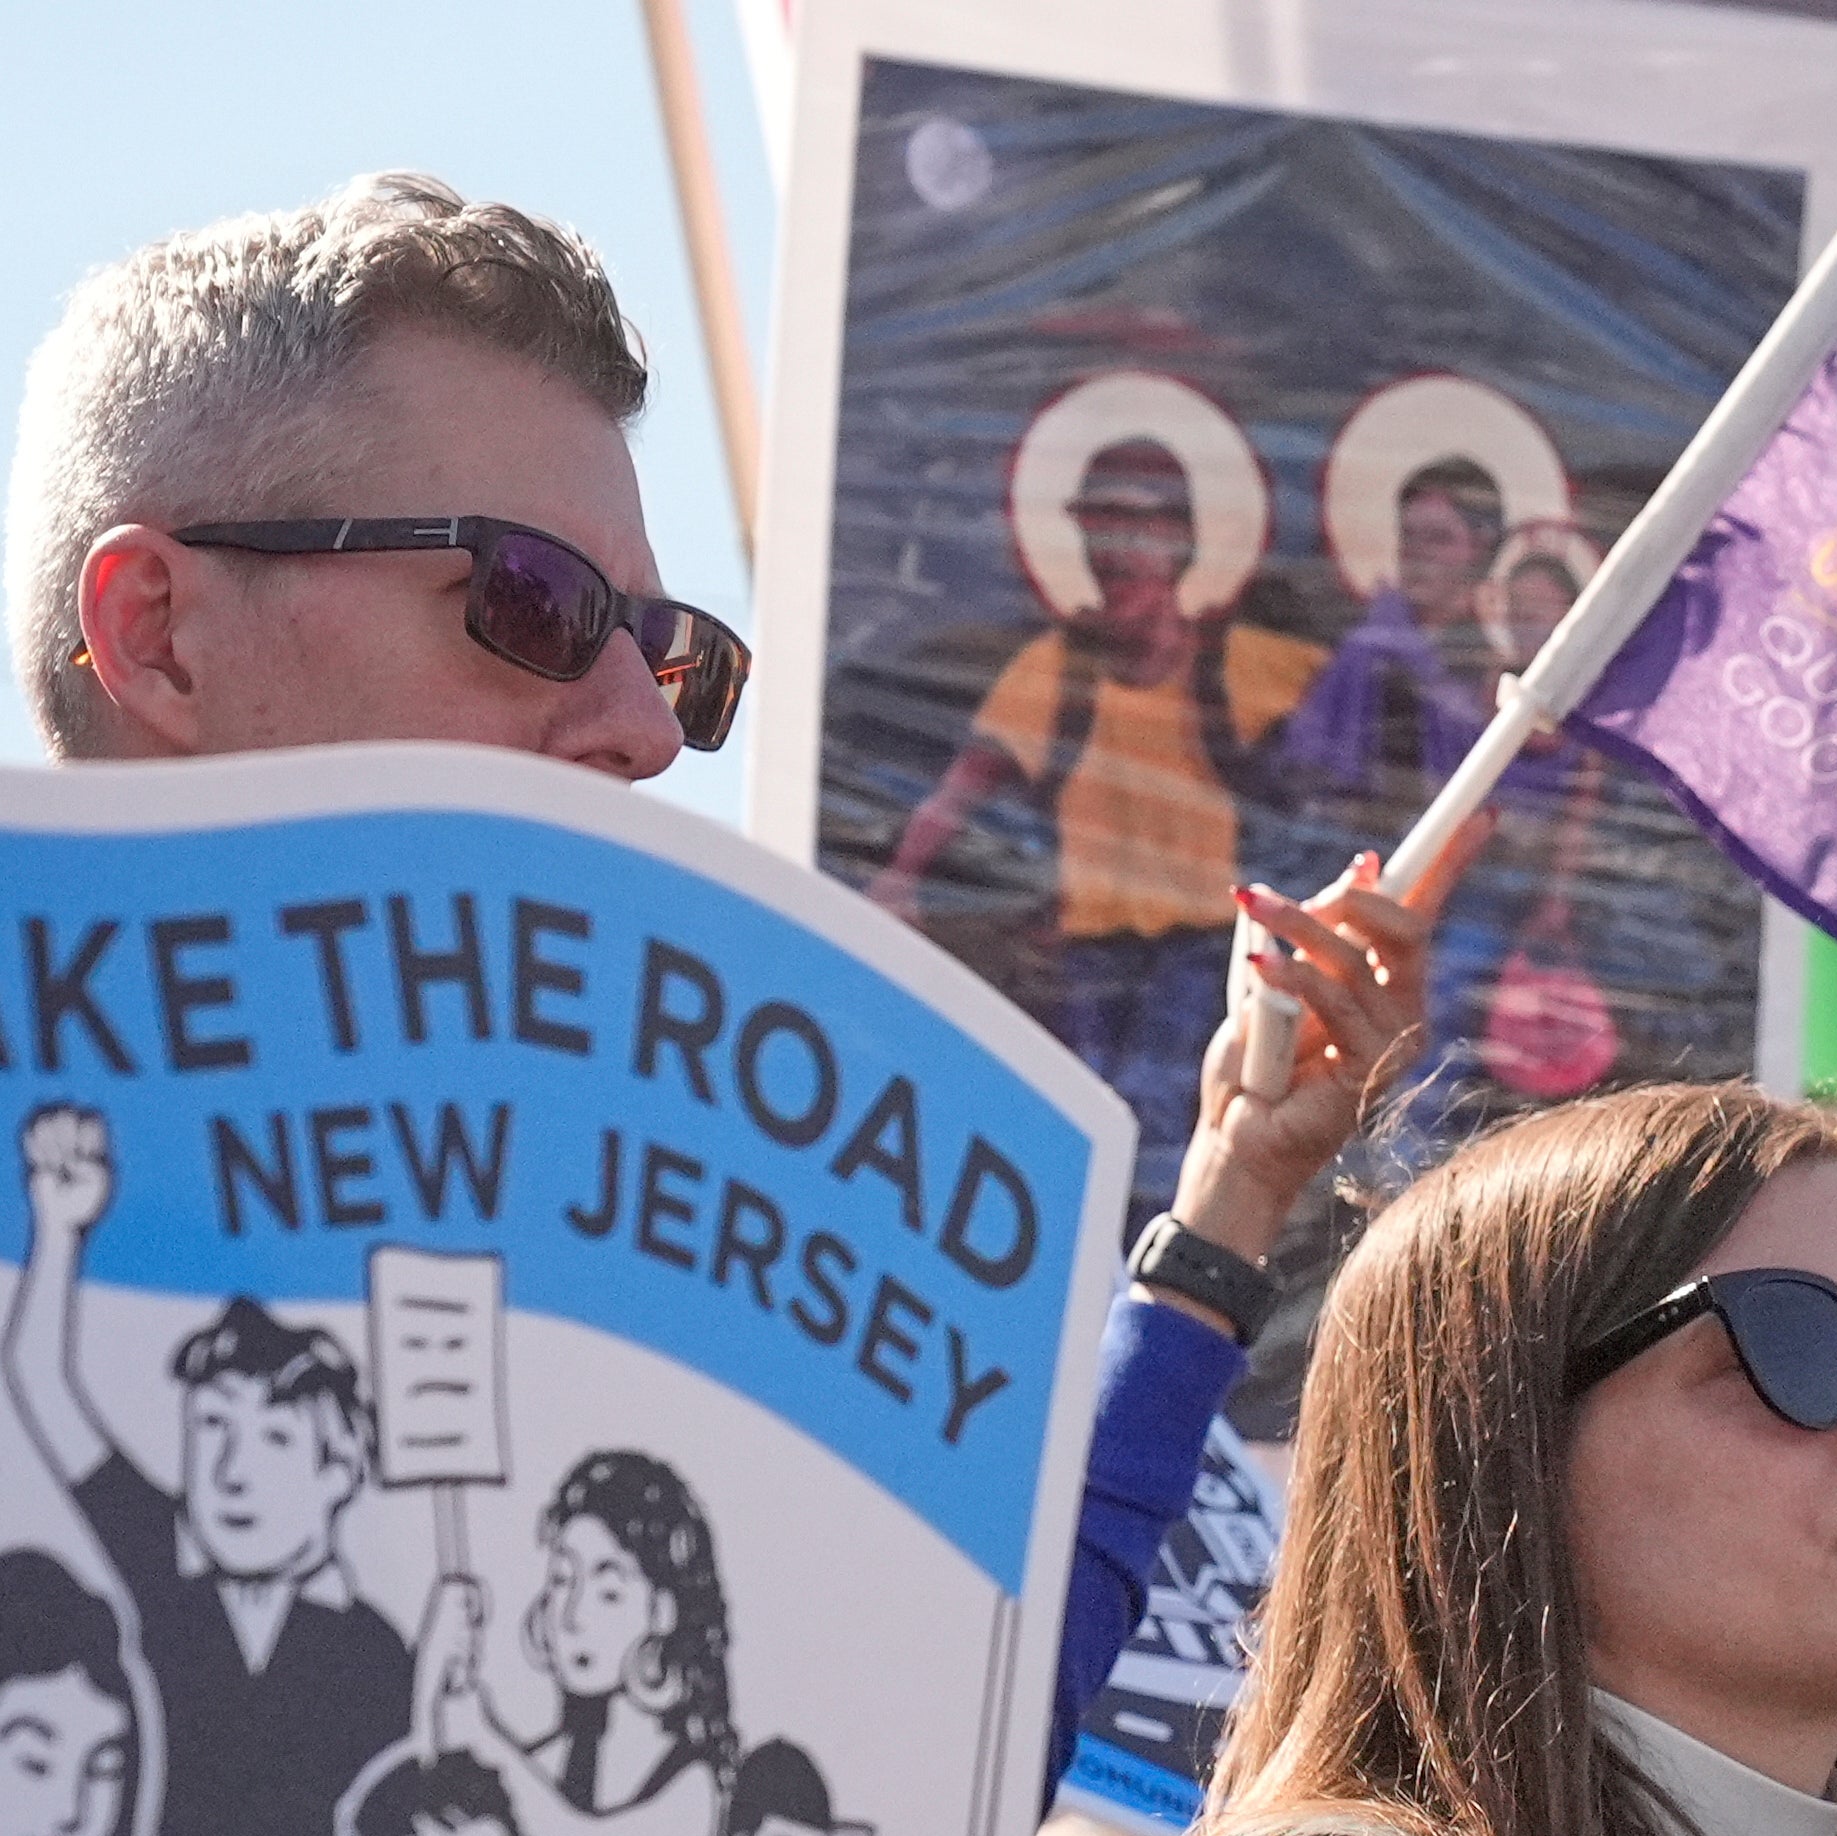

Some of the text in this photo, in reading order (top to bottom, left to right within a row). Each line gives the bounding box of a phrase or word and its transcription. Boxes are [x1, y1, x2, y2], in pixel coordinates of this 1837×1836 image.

[0, 892, 1040, 1293] KE THE ROAD
[209, 1102, 1011, 1447] NEW JERSEY
